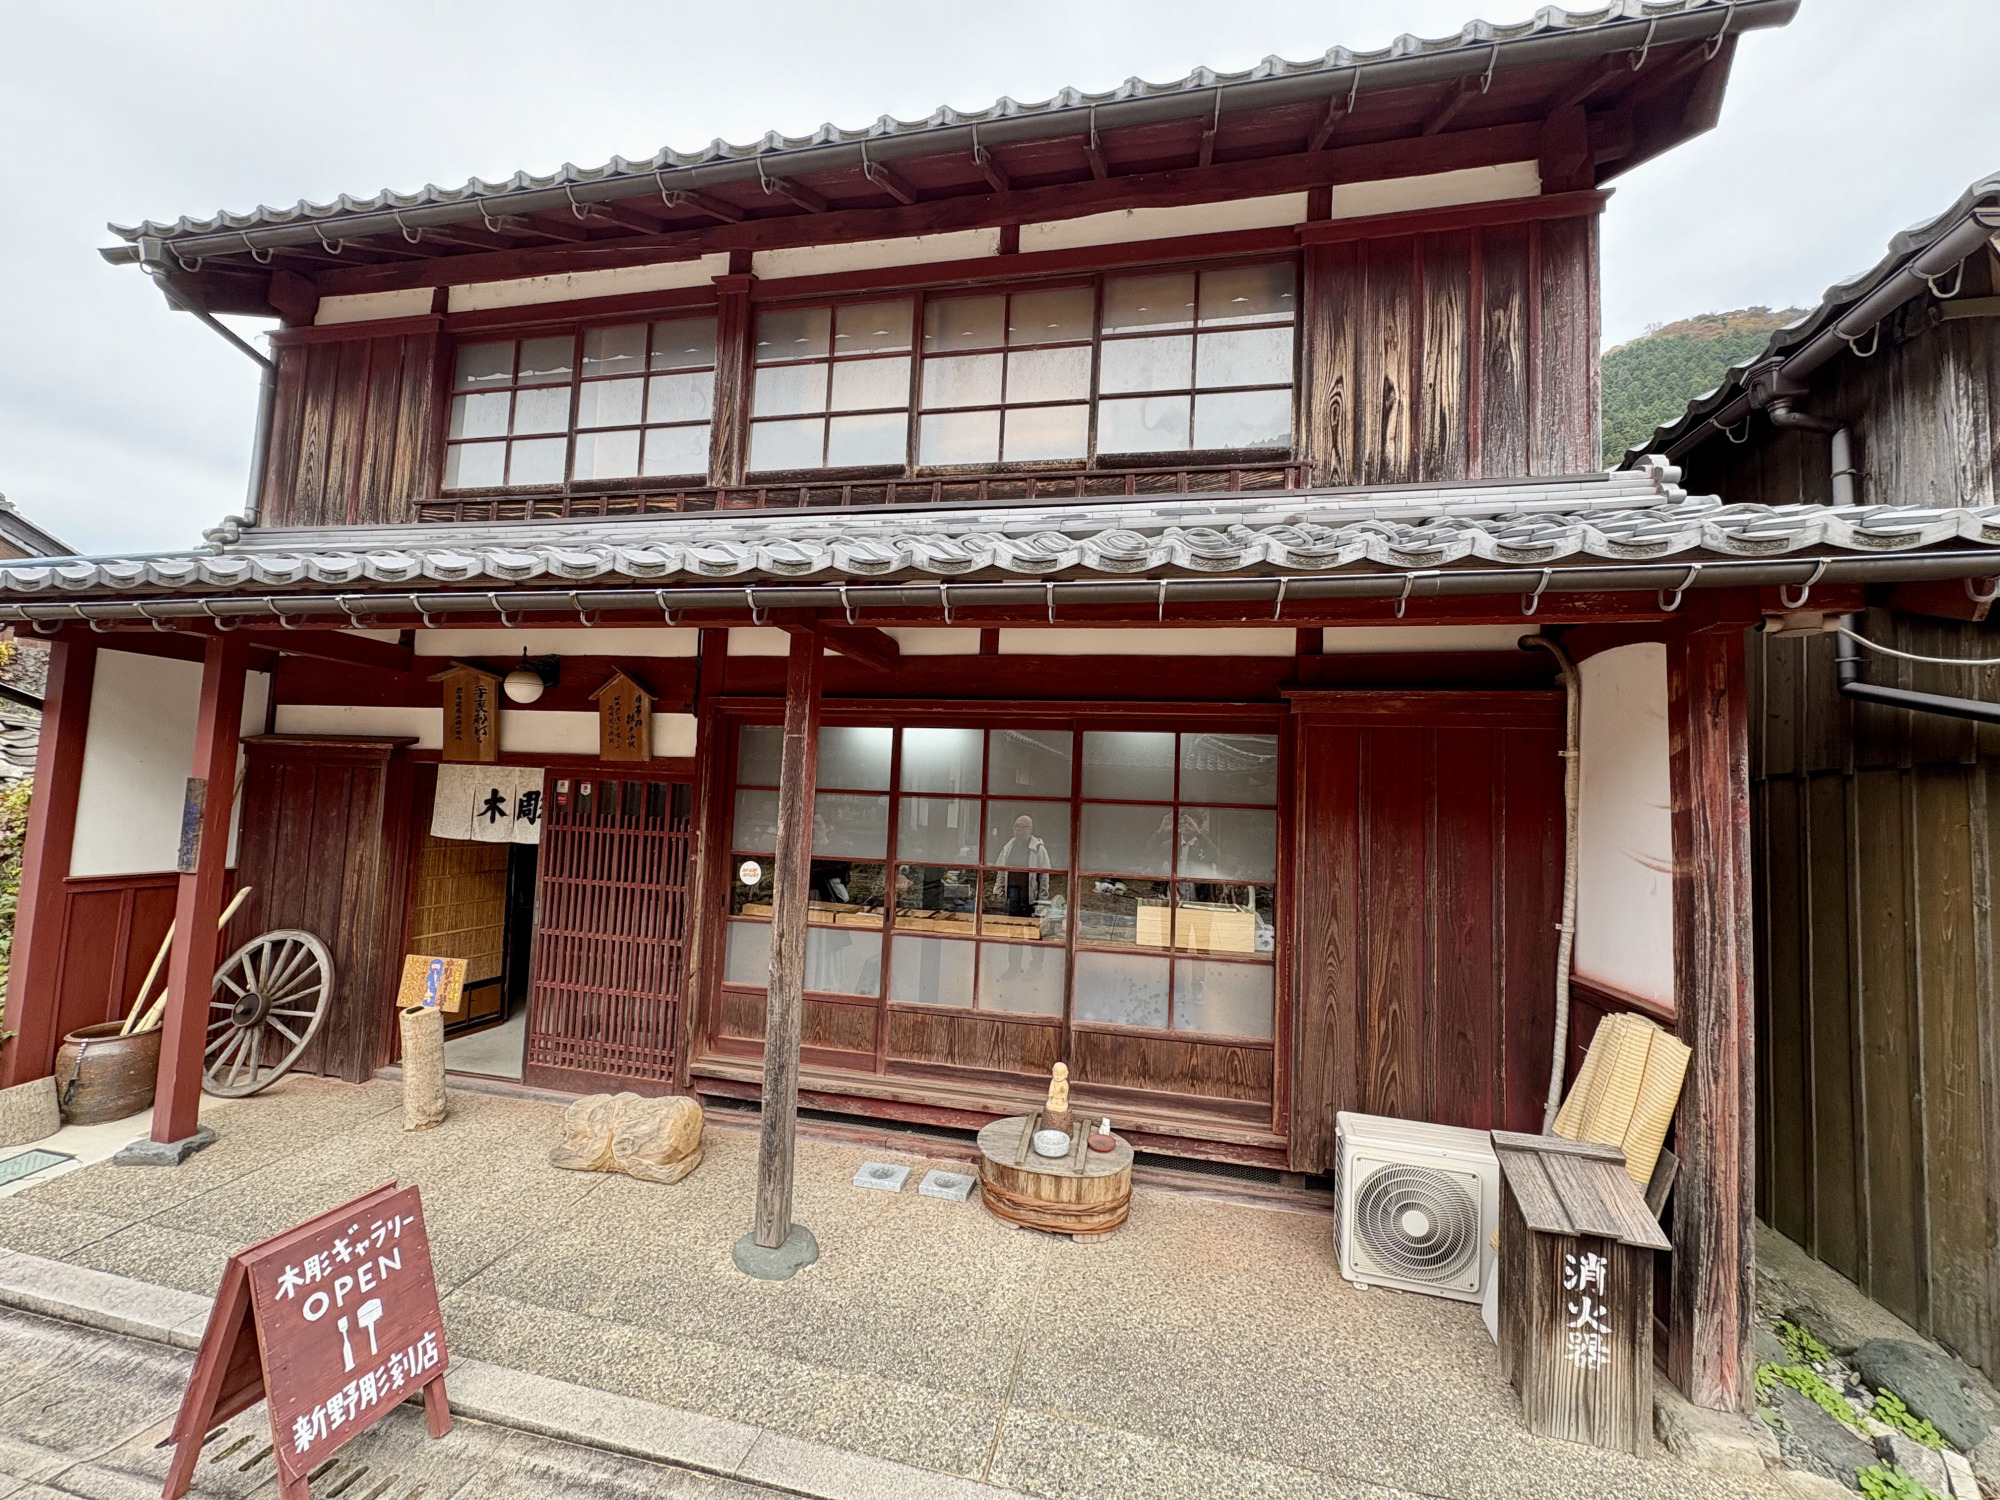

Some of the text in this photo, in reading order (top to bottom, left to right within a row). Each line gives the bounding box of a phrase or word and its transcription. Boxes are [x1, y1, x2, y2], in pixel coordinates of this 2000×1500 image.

[274, 1213, 415, 1302] 木彫ギャラリー
[302, 1247, 403, 1323] OPEN
[1563, 1252, 1612, 1372] 消火器
[291, 1329, 440, 1455] 新野彫刻店
